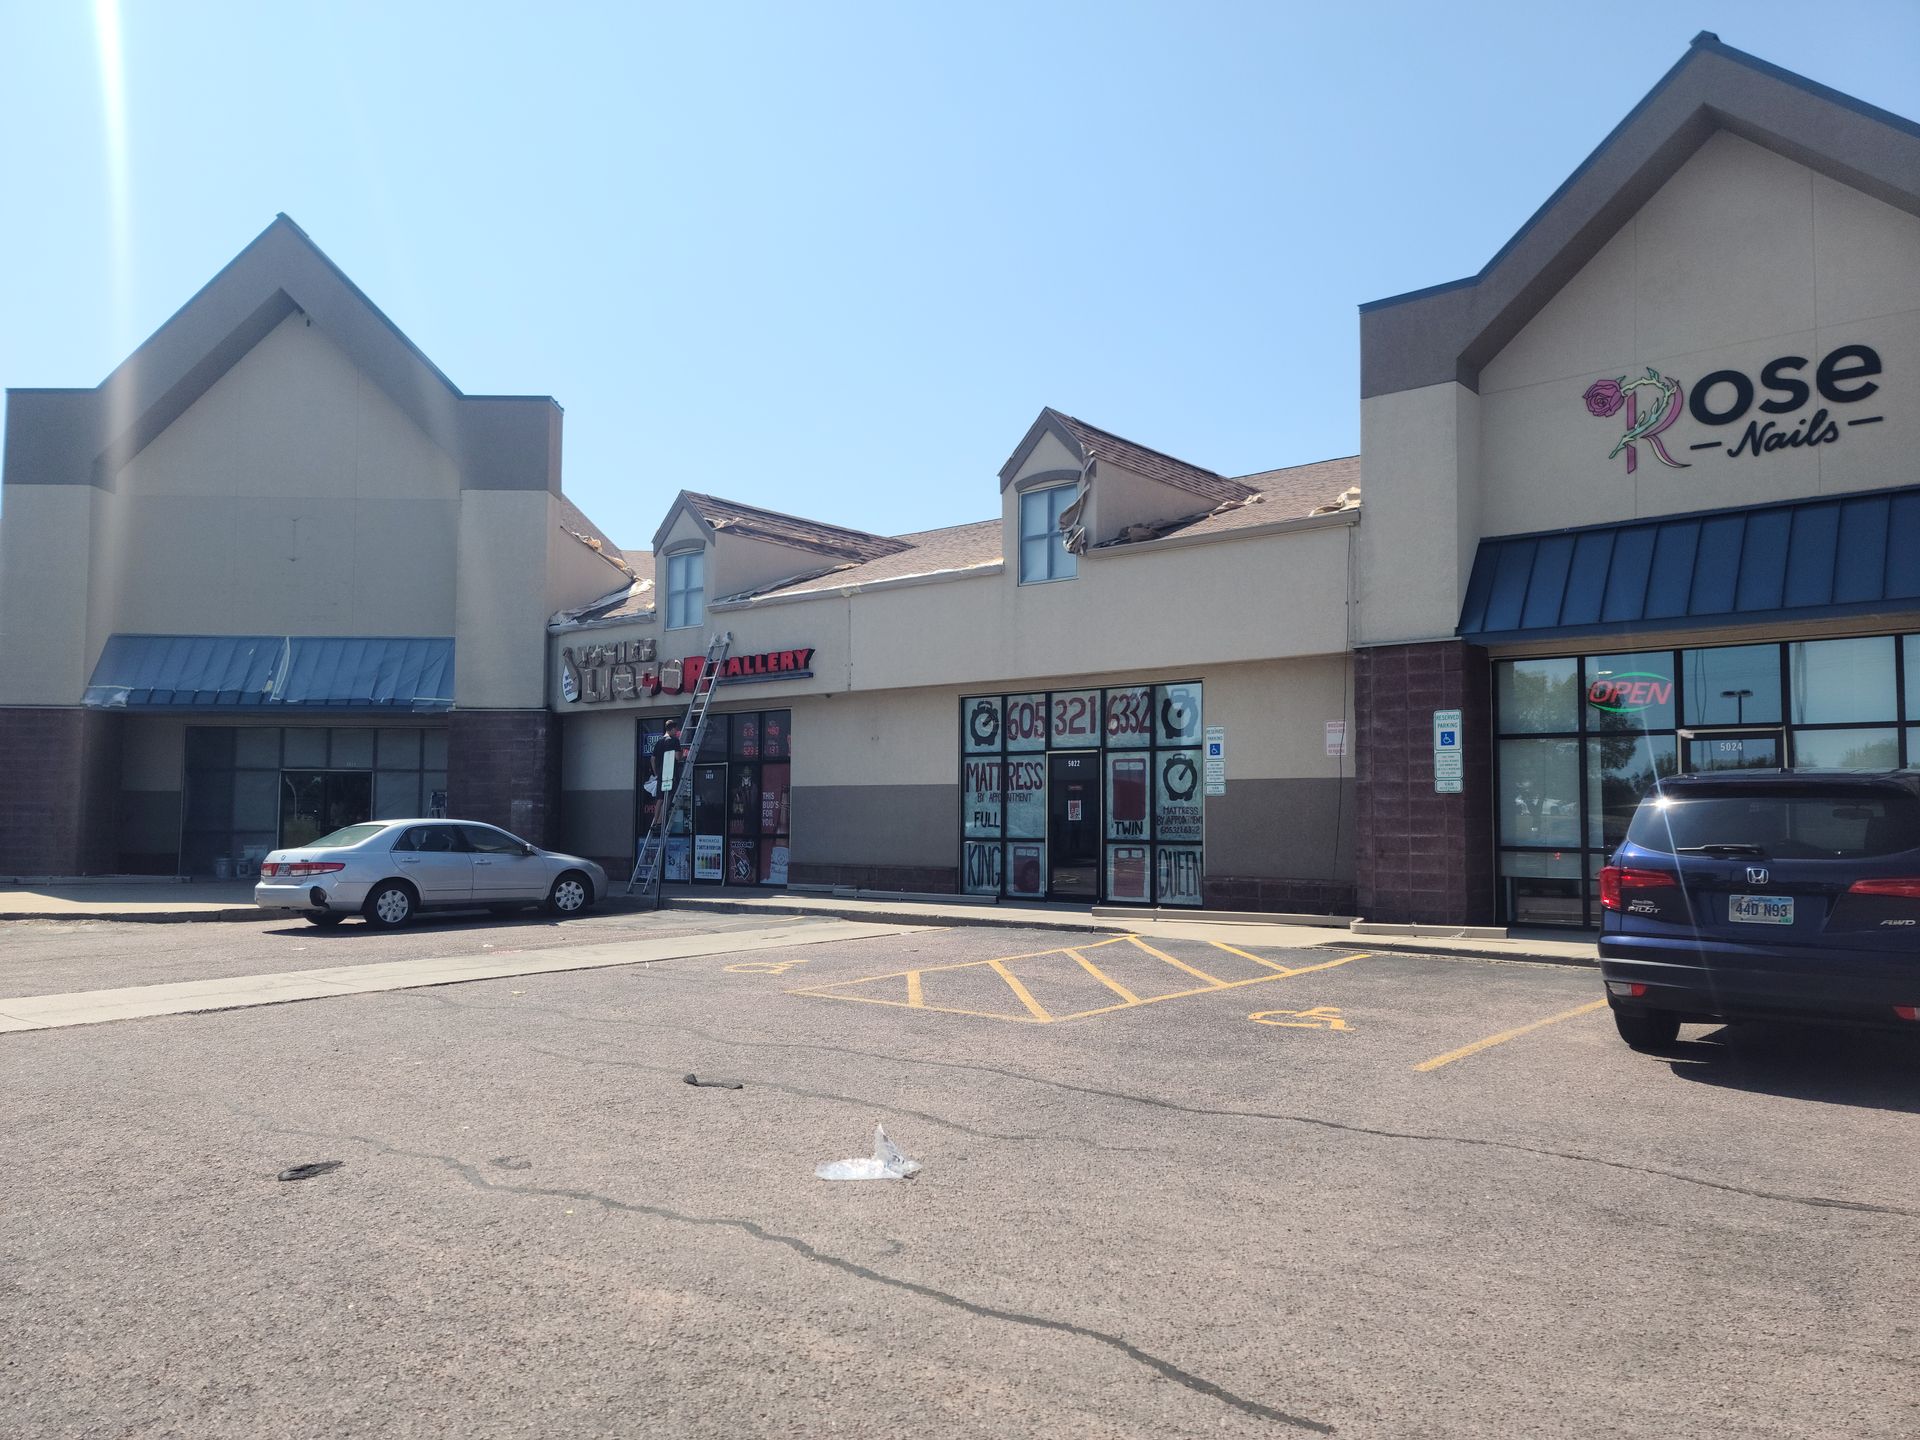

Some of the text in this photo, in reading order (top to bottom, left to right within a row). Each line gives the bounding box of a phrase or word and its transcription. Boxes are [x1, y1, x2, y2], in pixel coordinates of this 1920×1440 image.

[1610, 344, 1882, 474] Rose
[1727, 408, 1839, 458] Nails
[1589, 680, 1672, 706] OPEN
[1007, 691, 1151, 741] 605 321 6332
[1720, 742, 1742, 751] 5024
[965, 762, 1044, 793] MATTRESS
[762, 792, 775, 800] THIS
[977, 792, 1032, 803] BY APPONTMENT
[762, 801, 779, 809] BUD'S
[1163, 806, 1199, 815] MATTRESS
[762, 809, 774, 817] FOR
[974, 811, 1001, 828] FULL
[1114, 821, 1143, 835] TWIN
[1156, 816, 1165, 826] BY
[967, 844, 1001, 888] KING
[1157, 848, 1203, 899] QUEEN
[1627, 905, 1661, 914] PILOT
[1735, 902, 1788, 917] 44D N93
